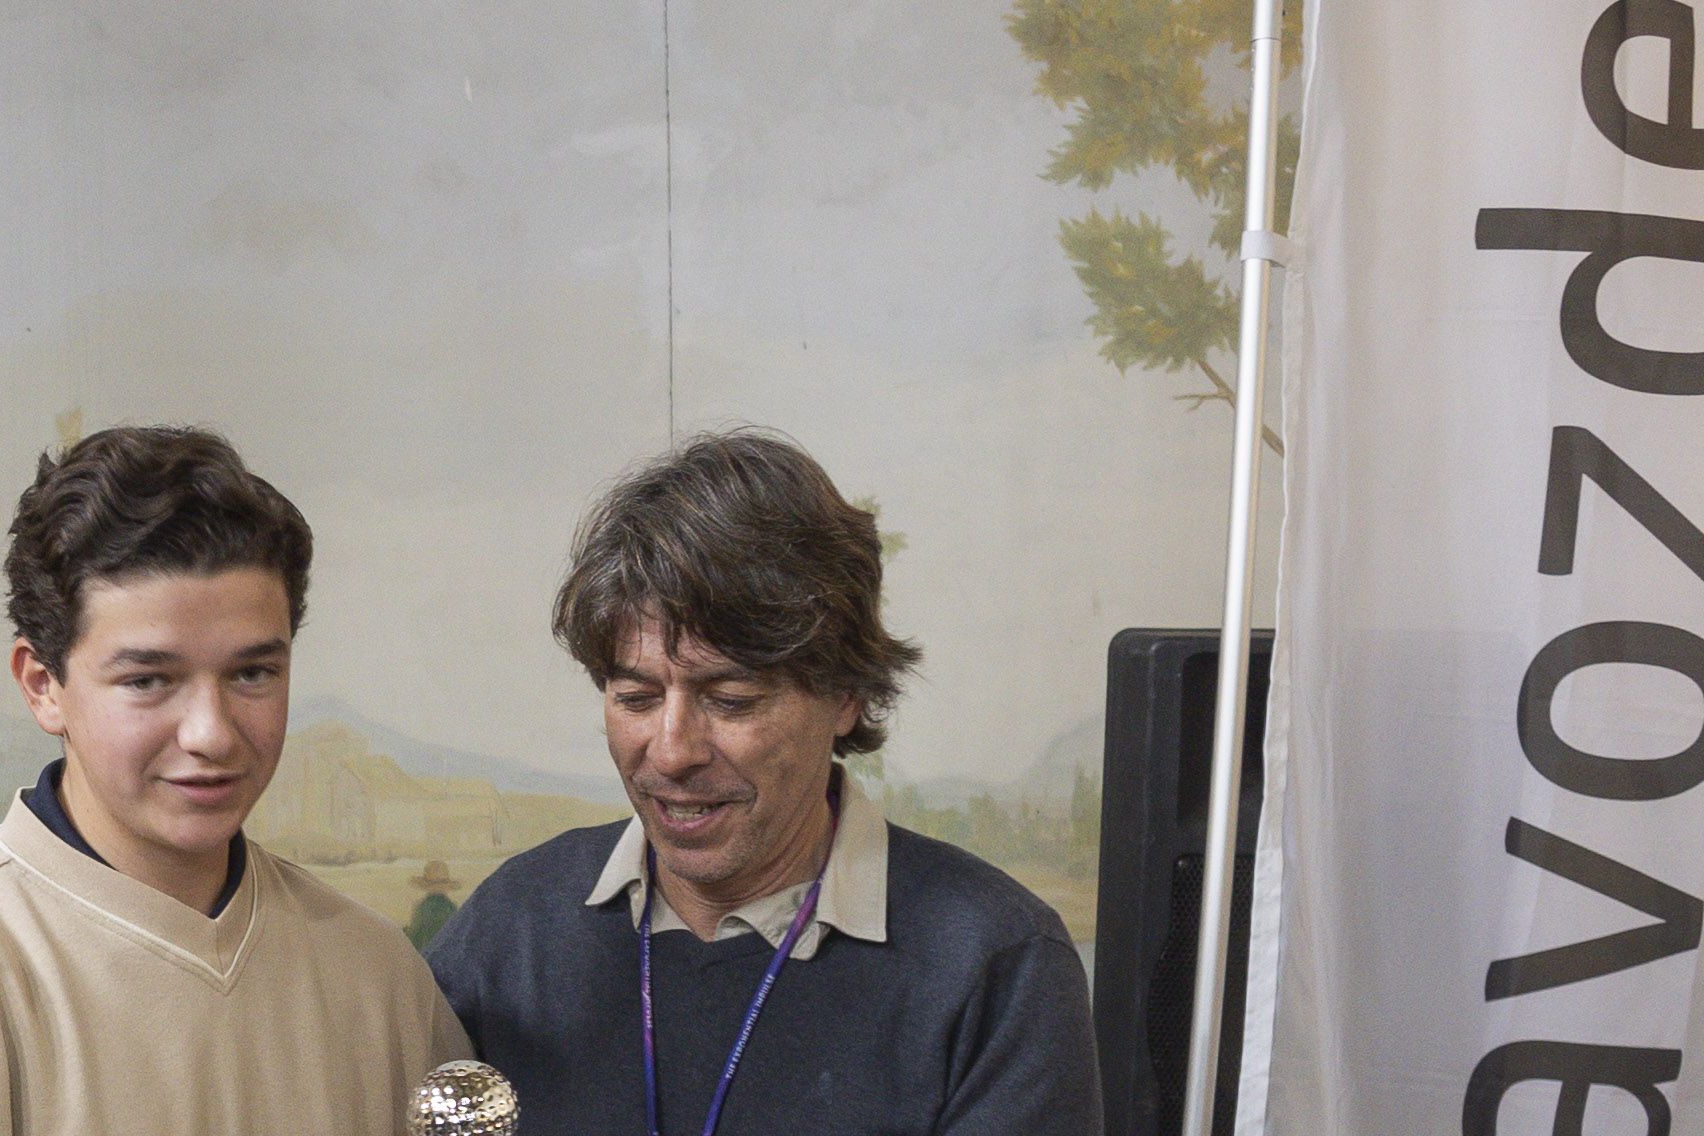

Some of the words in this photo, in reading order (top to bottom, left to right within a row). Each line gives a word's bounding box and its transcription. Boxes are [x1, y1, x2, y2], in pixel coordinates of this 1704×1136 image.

[726, 1063, 736, 1079] THE
[732, 1010, 759, 1063] EXPONENTIAL
[755, 973, 775, 1008] IMPULSE
